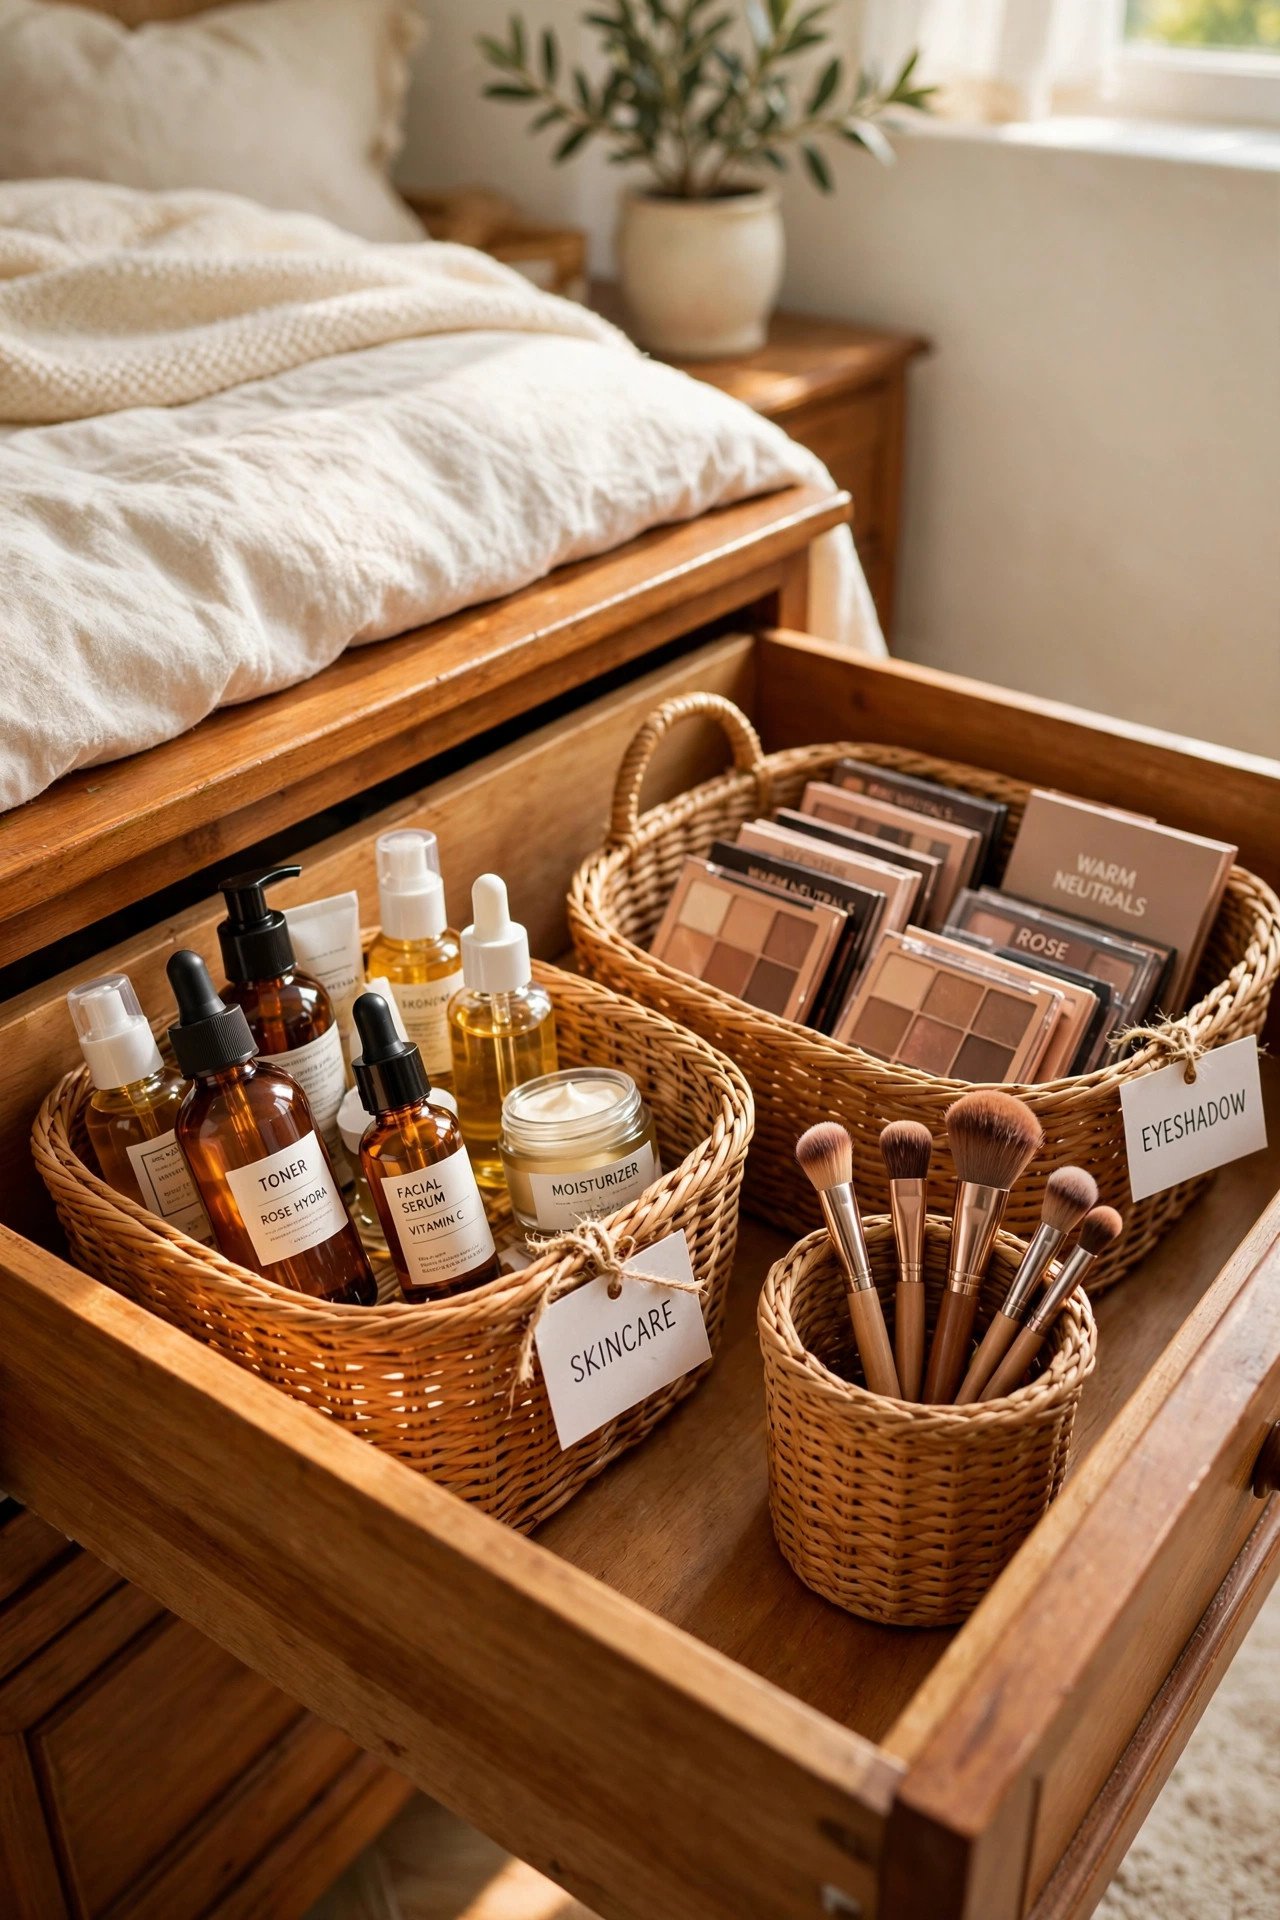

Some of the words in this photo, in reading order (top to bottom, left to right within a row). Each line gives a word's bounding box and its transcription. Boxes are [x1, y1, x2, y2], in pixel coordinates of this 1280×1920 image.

[1077, 853, 1137, 890] WARM
[1053, 870, 1148, 917] NEUTRALS
[1016, 928, 1070, 961] ROSE
[1142, 1089, 1246, 1153] EYESHADOW
[258, 1159, 308, 1192] TONER
[397, 1178, 443, 1199] FACIAL
[552, 1162, 640, 1196] MOISTURIZER
[260, 1206, 293, 1225] ROSE
[293, 1187, 328, 1212] HYDRA
[402, 1192, 446, 1214] SERUM
[408, 1214, 455, 1236] VITAMIN
[456, 1210, 465, 1220] C
[570, 1299, 677, 1383] SKINCARE
